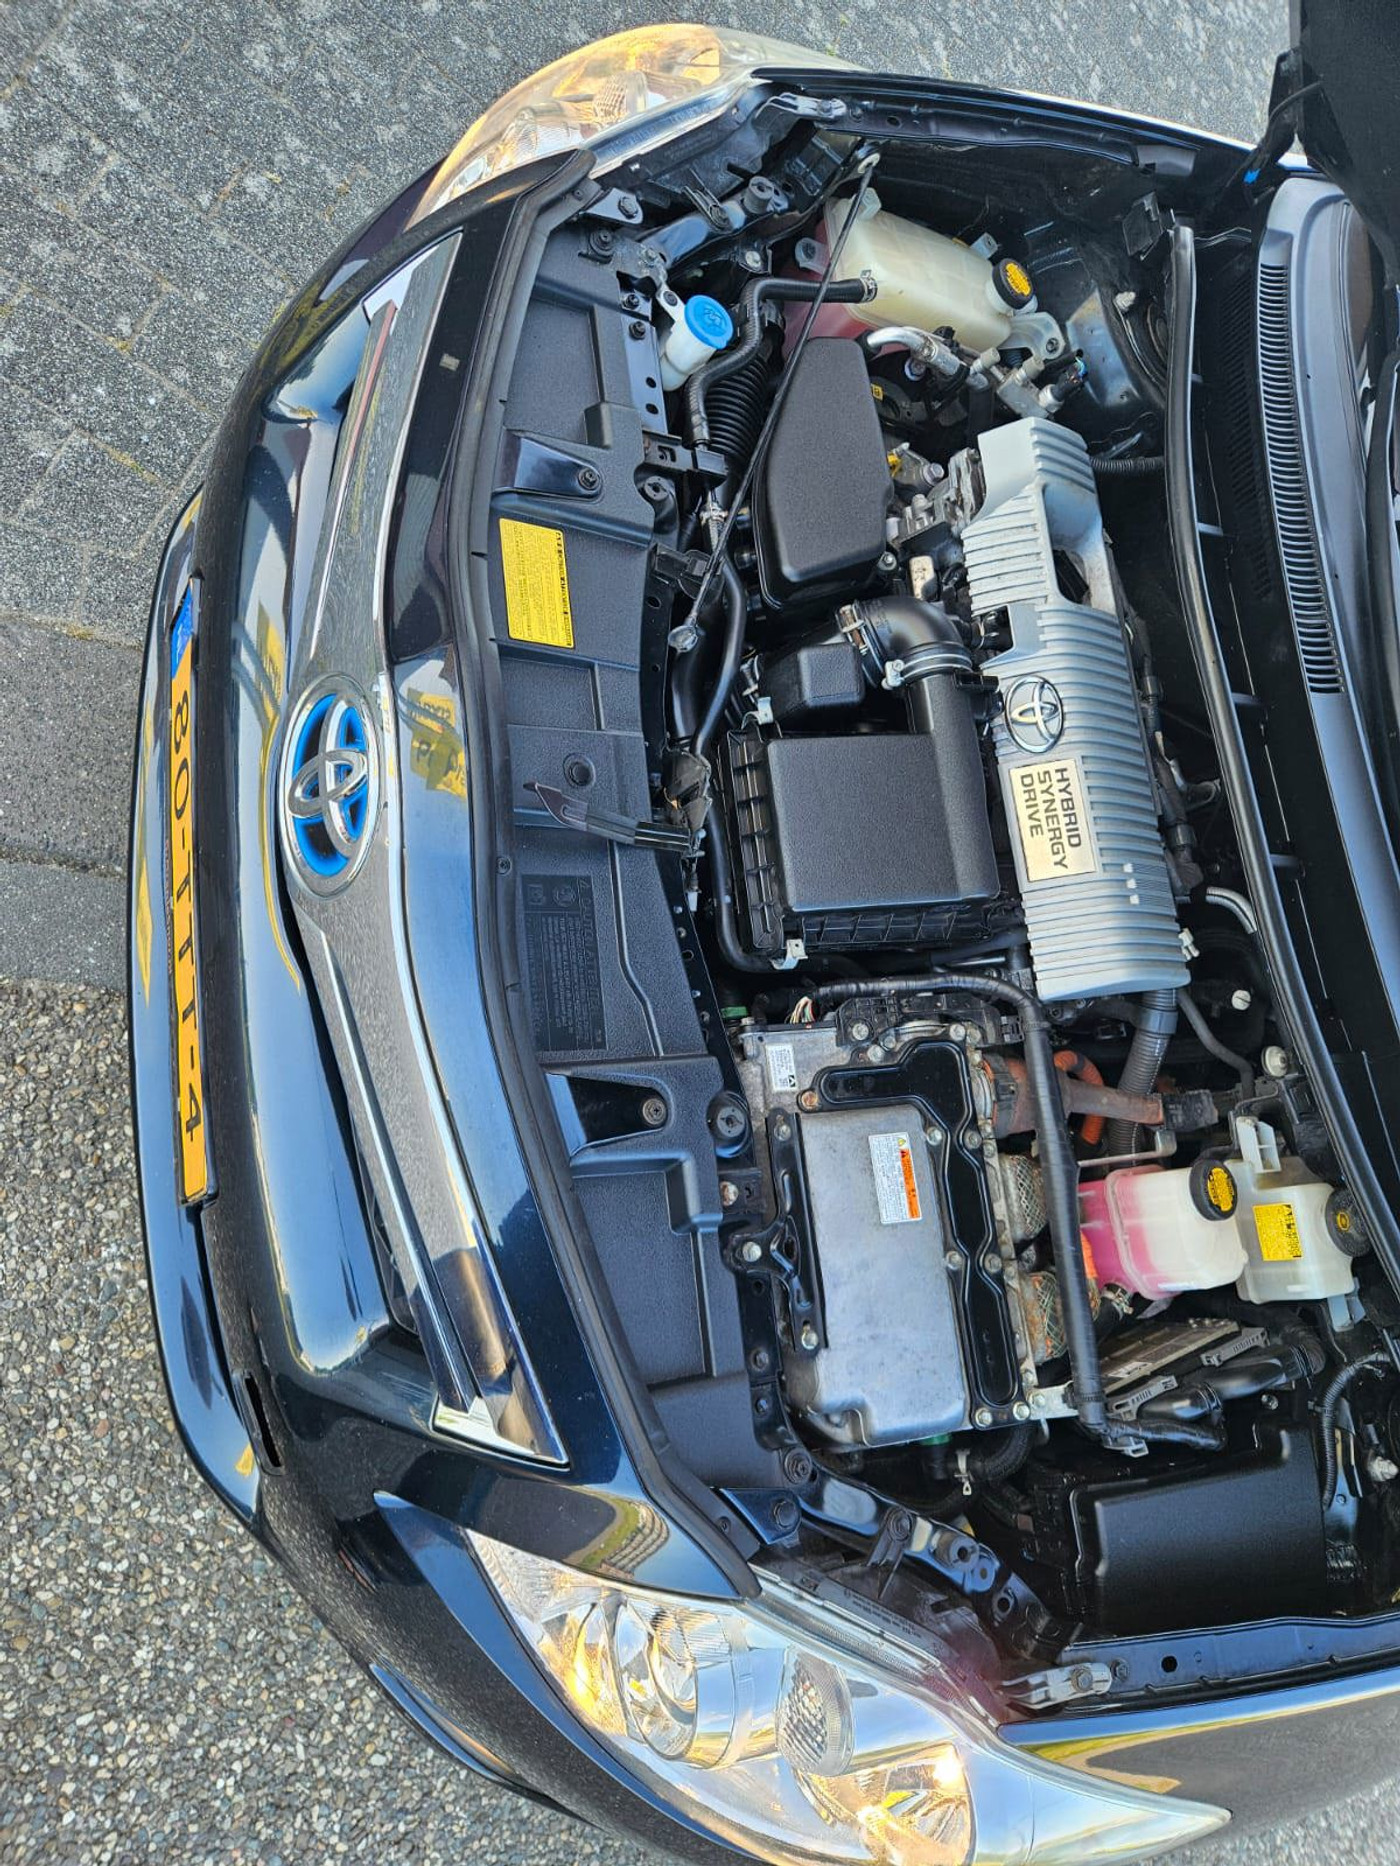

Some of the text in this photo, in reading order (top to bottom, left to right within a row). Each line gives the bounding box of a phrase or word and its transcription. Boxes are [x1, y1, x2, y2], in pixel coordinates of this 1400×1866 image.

[1020, 773, 1044, 838] DRIVE
[1038, 770, 1068, 869] SYNERGY
[1055, 768, 1081, 848] HYBRID
[174, 691, 201, 1142] 80-TTT-4
